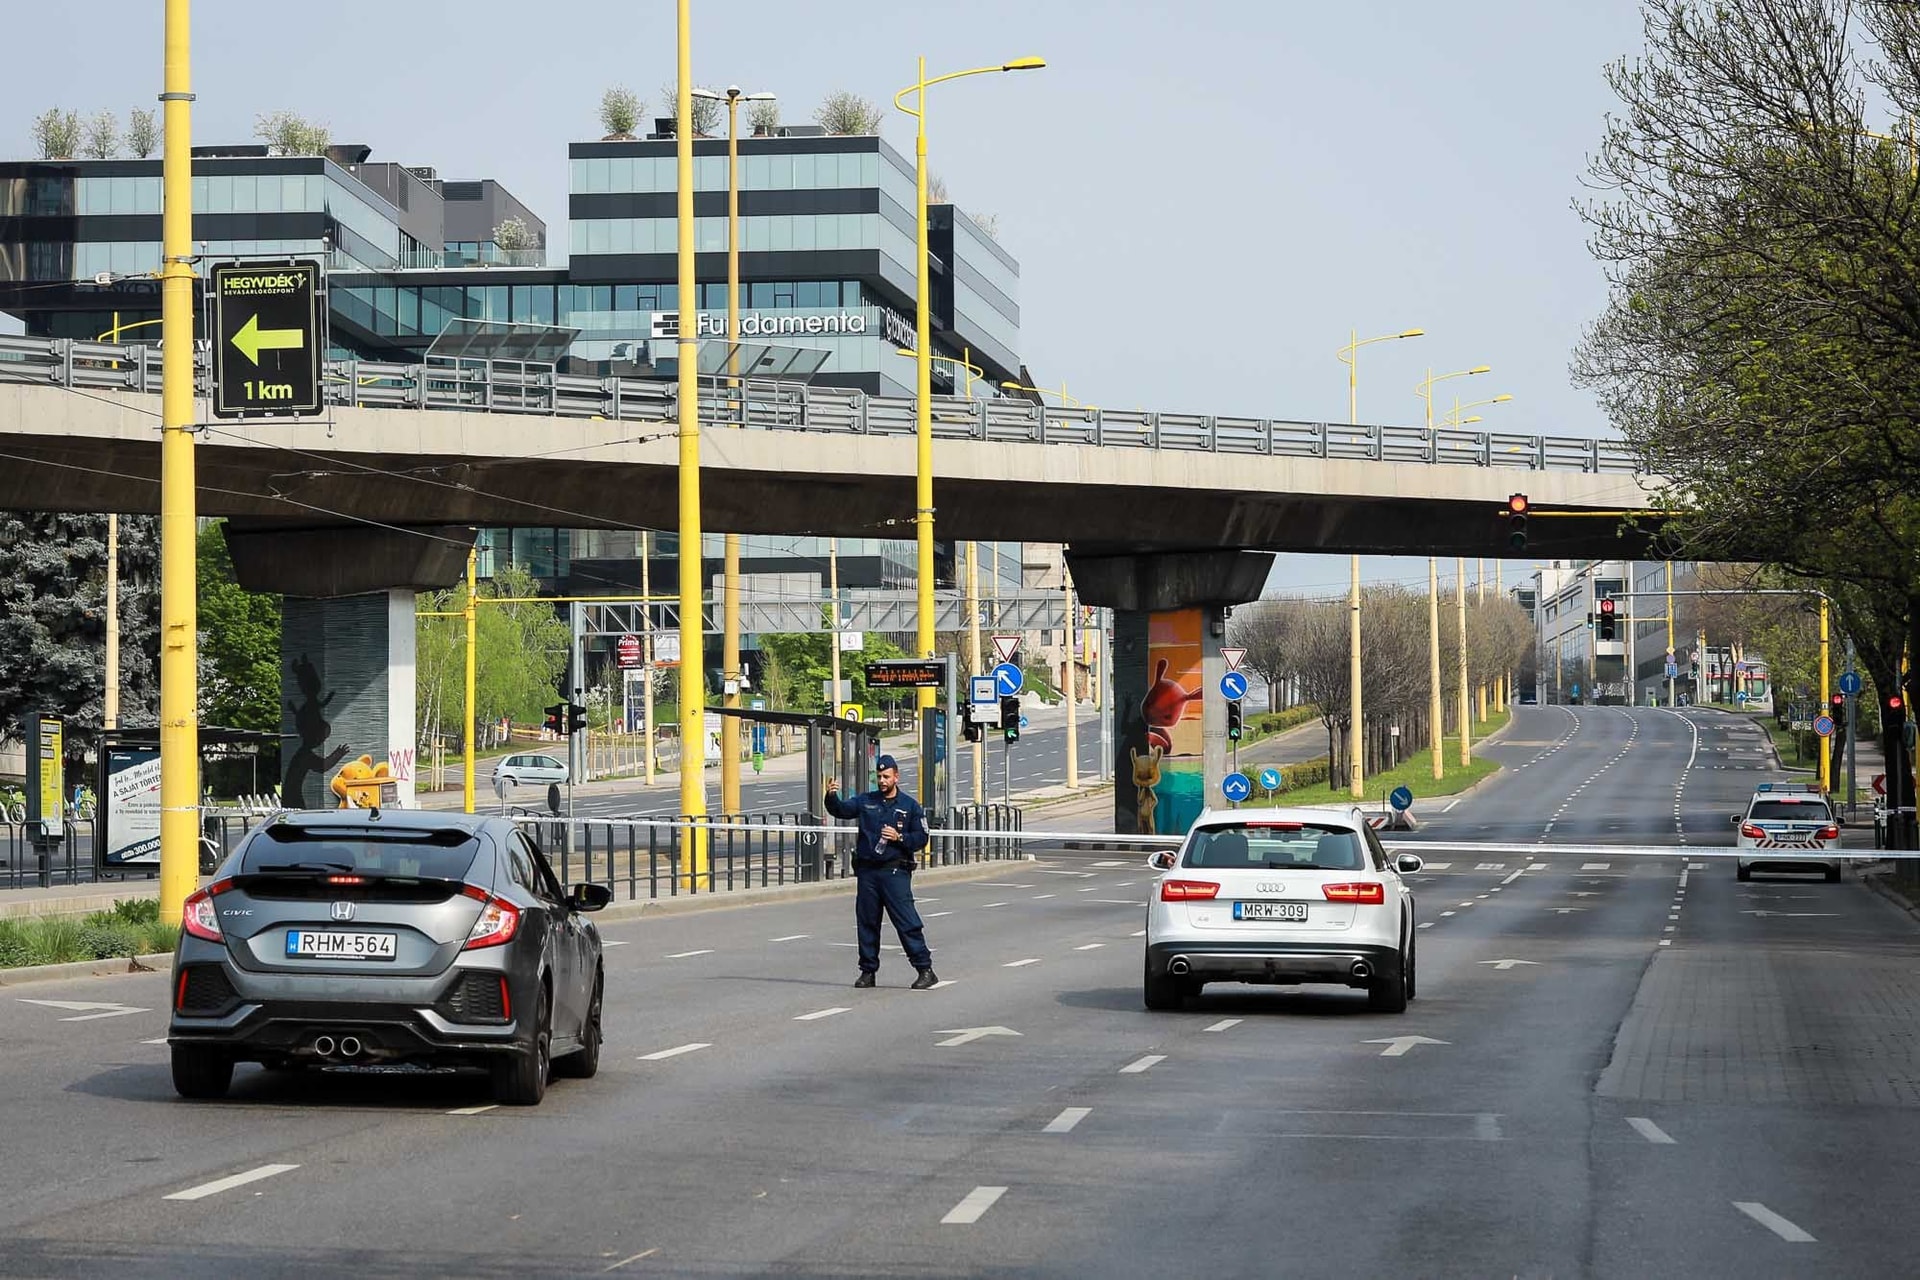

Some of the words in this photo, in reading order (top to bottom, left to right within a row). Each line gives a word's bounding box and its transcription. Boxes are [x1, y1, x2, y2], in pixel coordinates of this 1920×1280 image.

[224, 274, 294, 289] HEGYVIDÉK
[243, 381, 252, 400] 1
[259, 380, 293, 399] km
[618, 638, 640, 646] Prima
[1244, 904, 1304, 917] MRW-309
[303, 934, 390, 953] RHM-564
